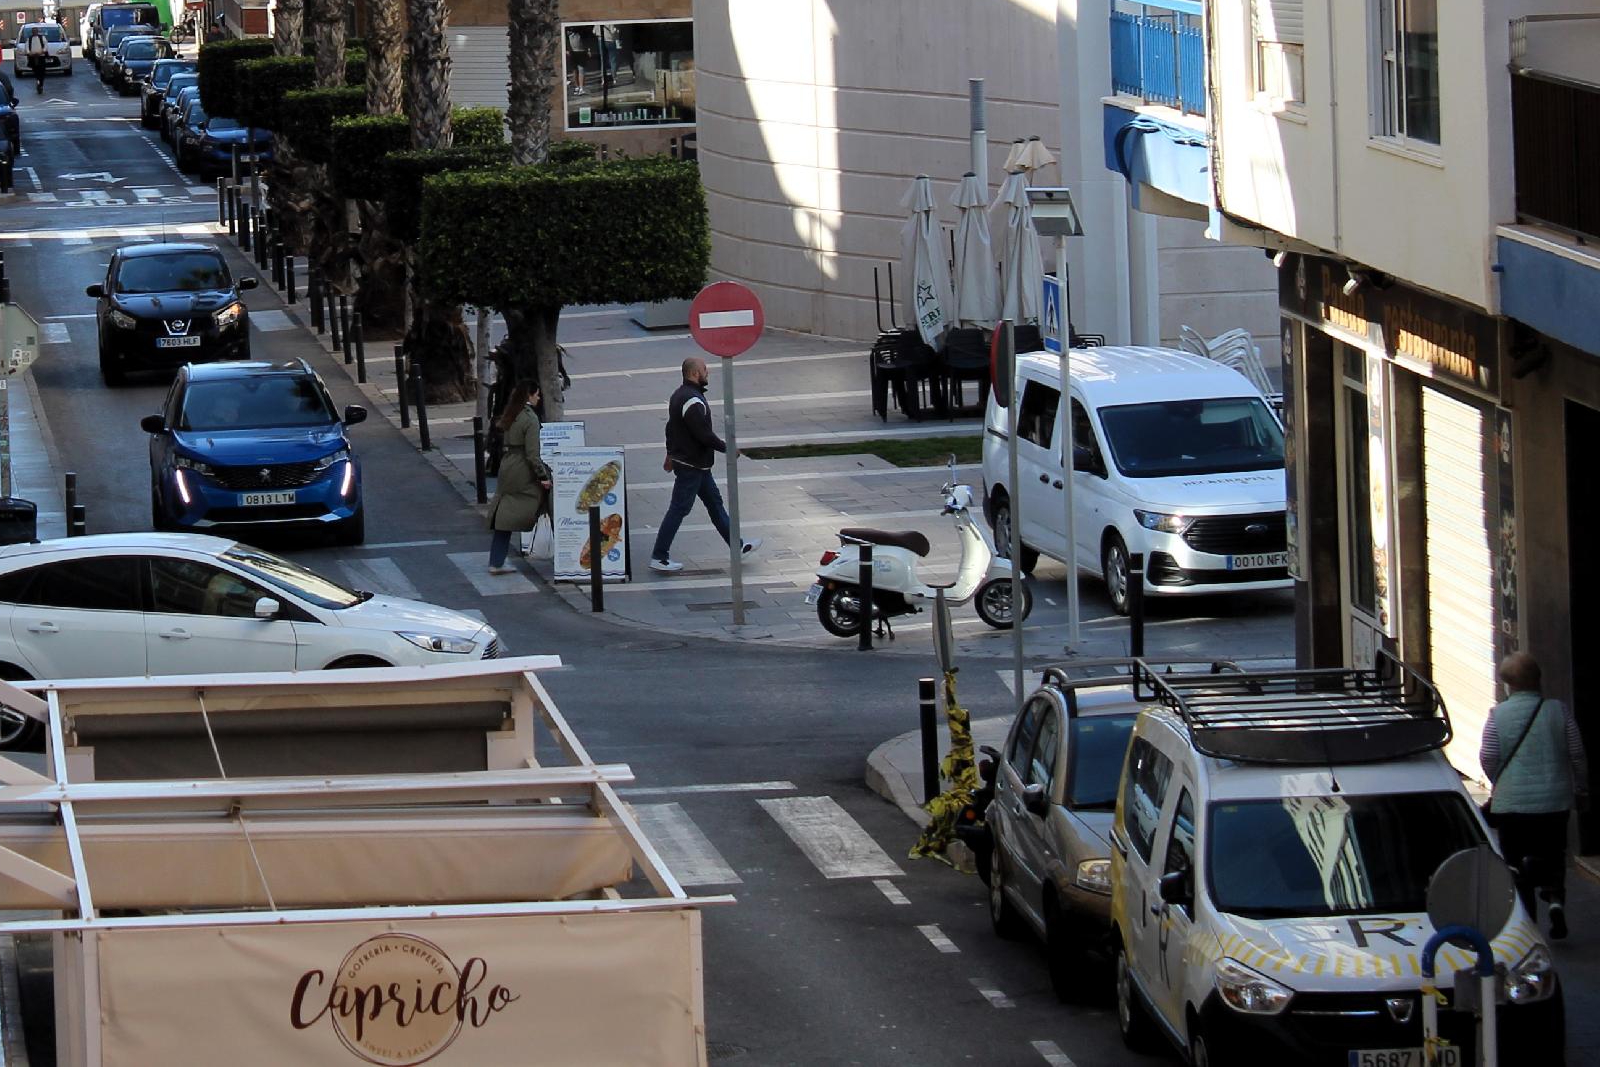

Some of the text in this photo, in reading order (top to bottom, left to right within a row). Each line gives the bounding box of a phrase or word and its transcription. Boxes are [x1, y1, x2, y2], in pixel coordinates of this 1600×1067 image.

[246, 494, 294, 504] 0813 LTM
[1235, 554, 1288, 568] 0010 NFK
[348, 944, 445, 979] GOFRERÍA CREPERÍA
[290, 957, 521, 1042] Capricho
